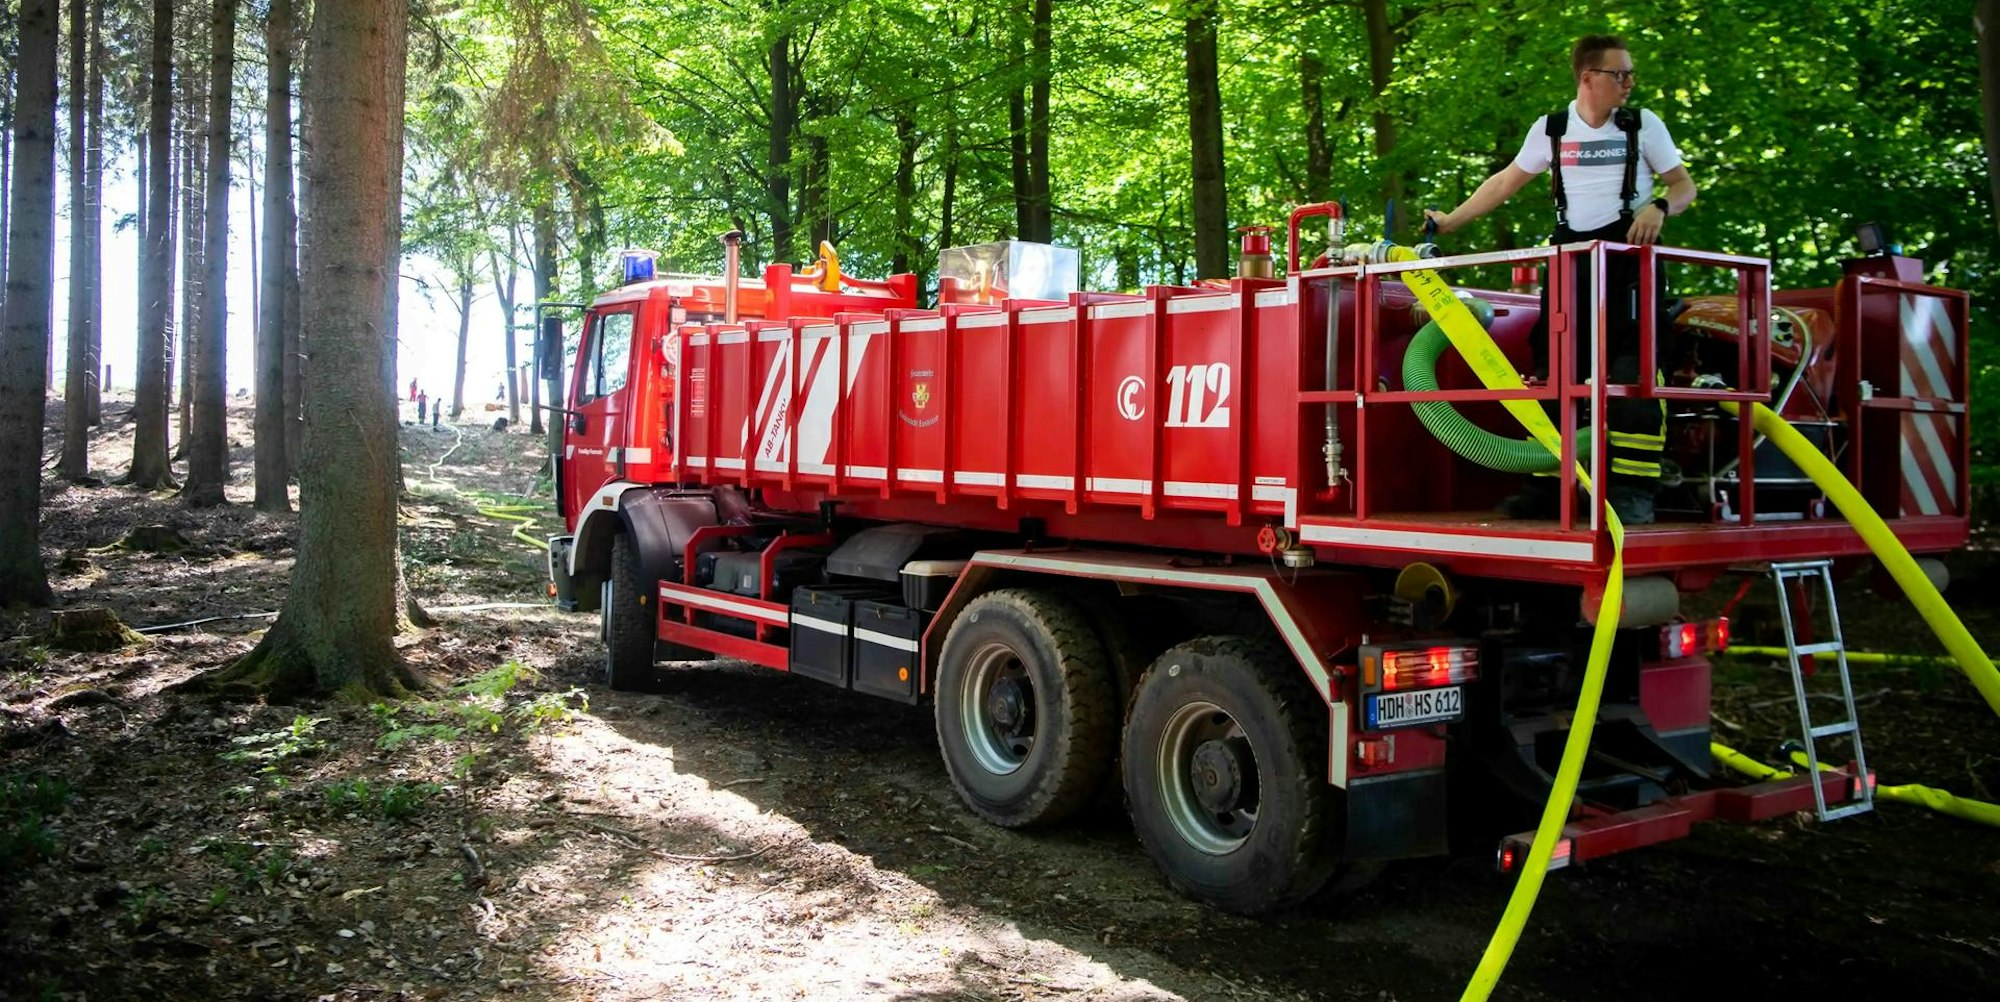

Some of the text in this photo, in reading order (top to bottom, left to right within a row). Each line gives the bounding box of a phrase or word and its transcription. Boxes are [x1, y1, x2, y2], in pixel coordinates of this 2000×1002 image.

[1164, 362, 1230, 427] 112
[1378, 697, 1405, 720] HDH
[1415, 694, 1431, 716] HS
[1435, 690, 1459, 713] 612
